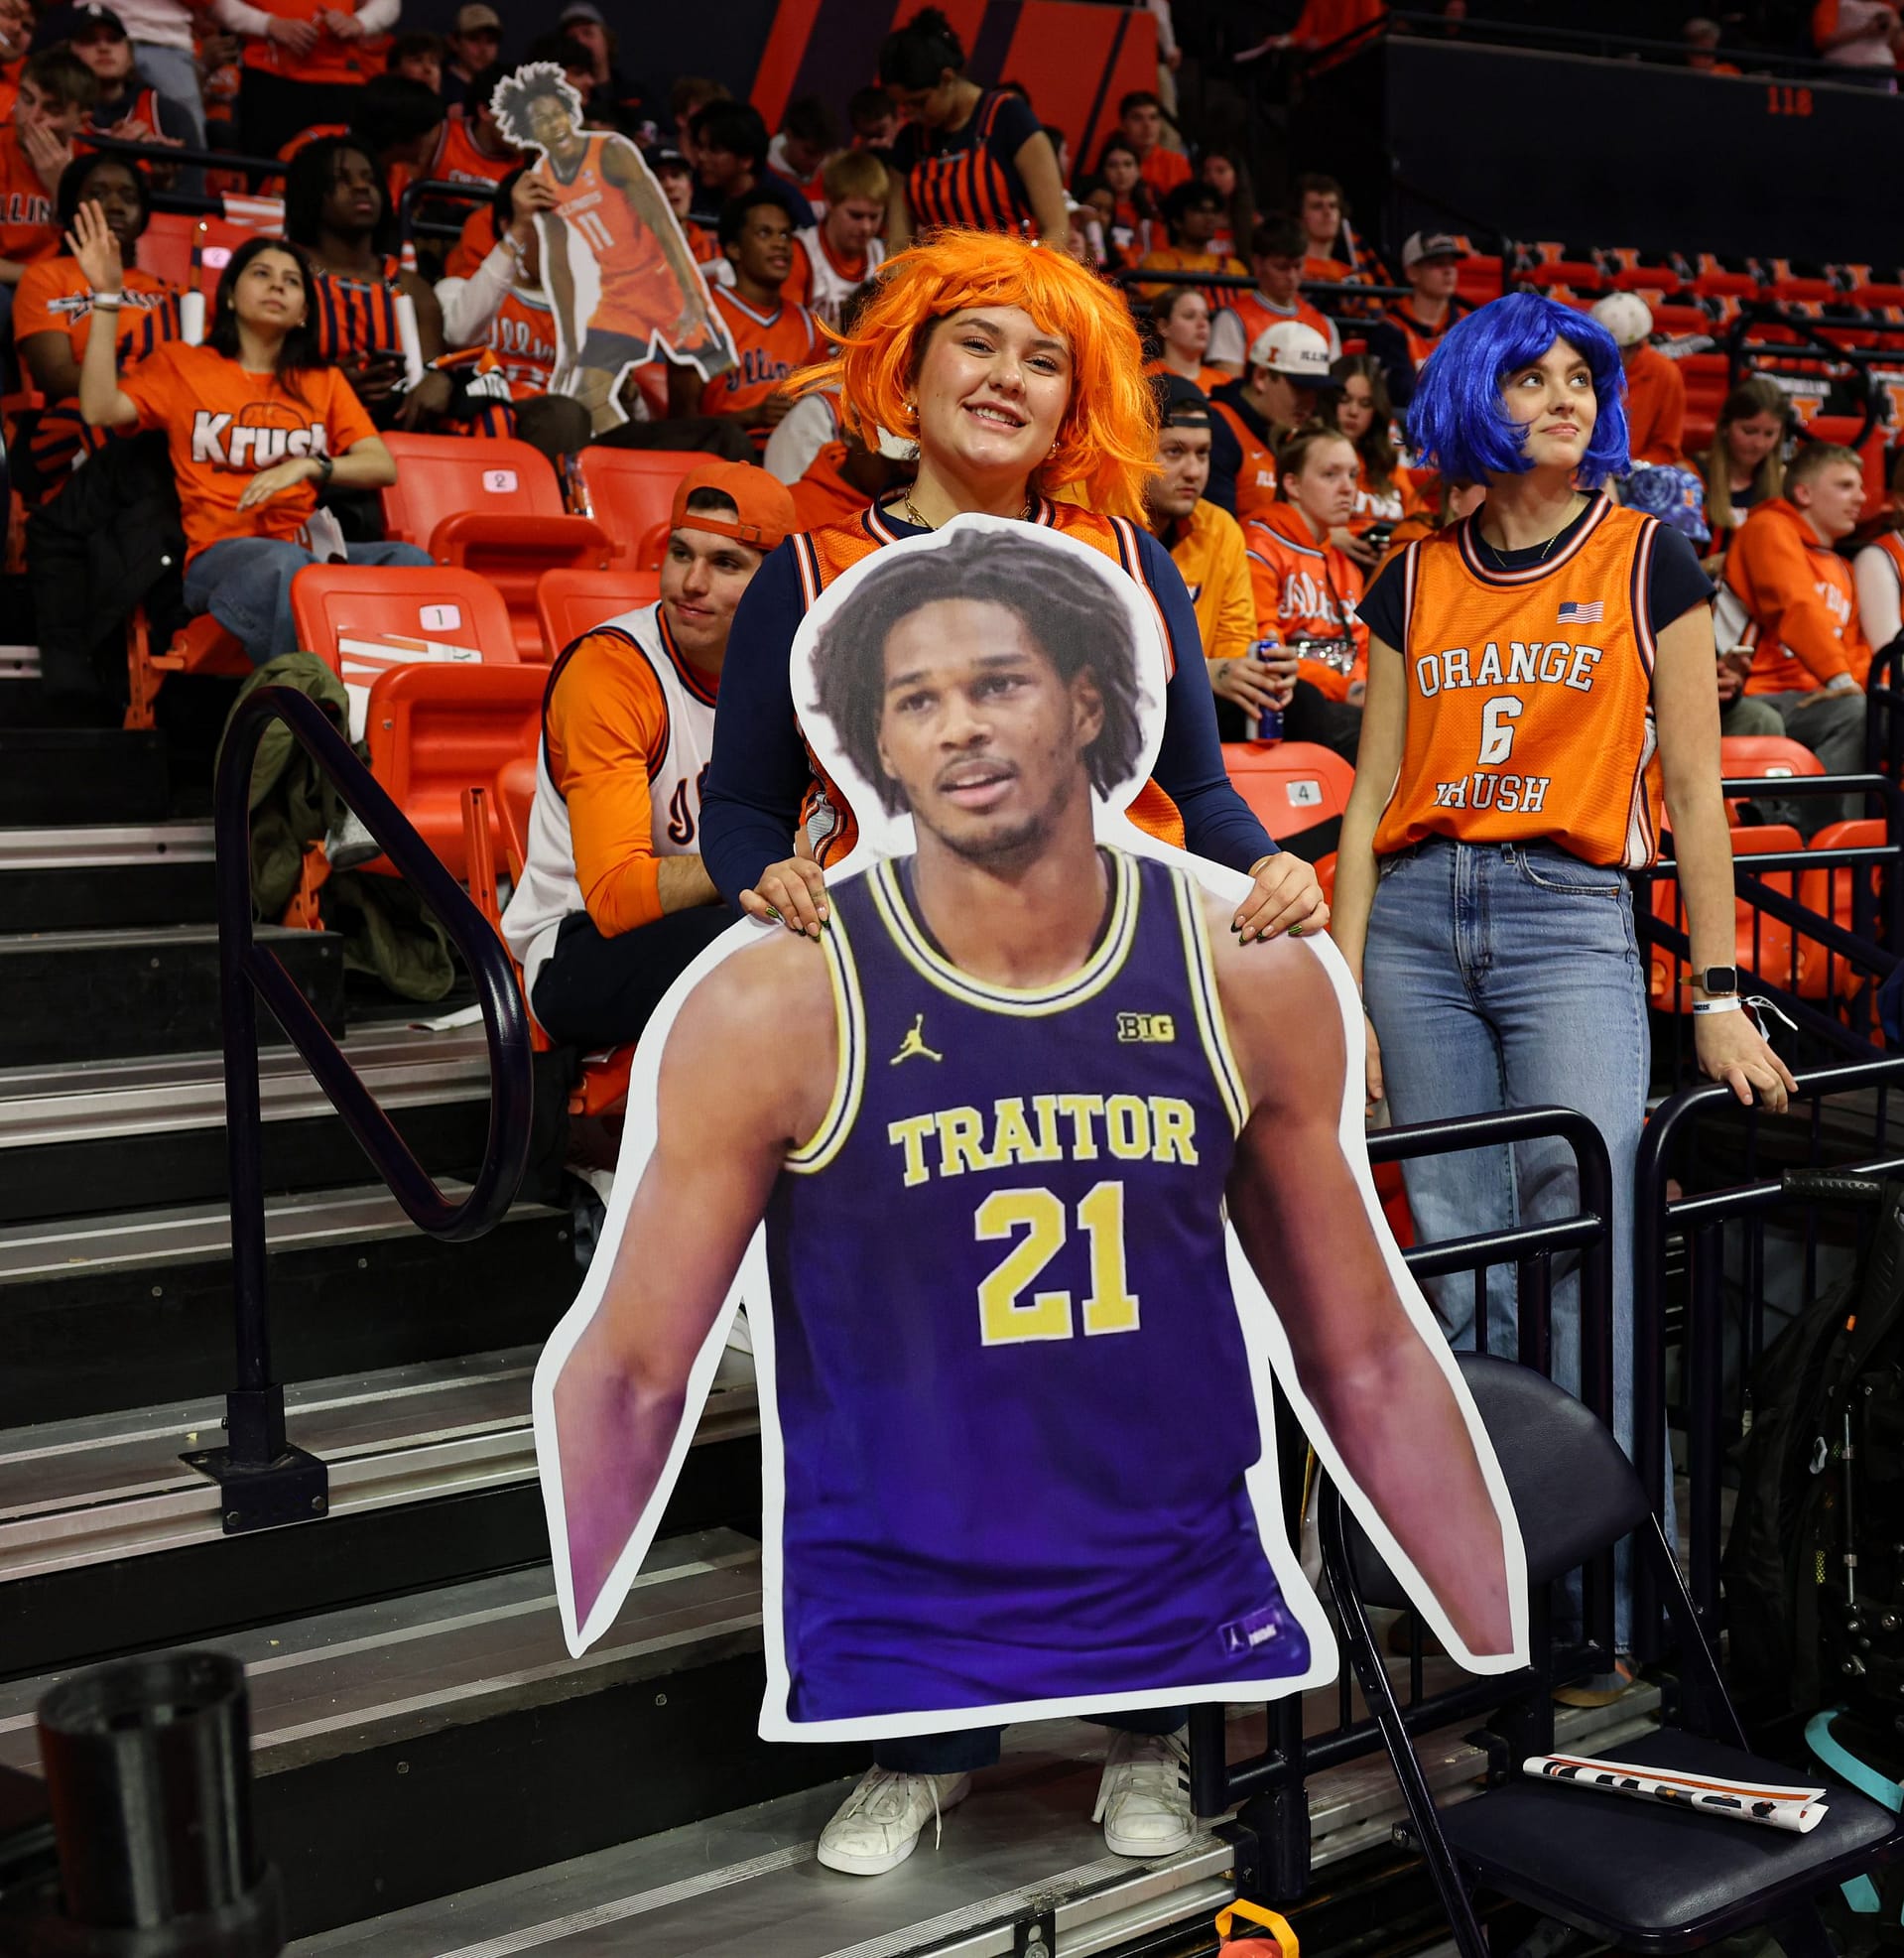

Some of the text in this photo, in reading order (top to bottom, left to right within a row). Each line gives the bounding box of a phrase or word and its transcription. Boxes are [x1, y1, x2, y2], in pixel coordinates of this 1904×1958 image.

[1768, 85, 1814, 117] 118
[576, 209, 615, 251] 11
[494, 472, 507, 487] 2
[1416, 641, 1603, 698] ORANGE
[1477, 696, 1524, 766] 6
[1299, 785, 1310, 801] 4
[1117, 1012, 1176, 1042] BIG
[888, 1094, 1199, 1188] TRAITOR
[974, 1180, 1141, 1347] 21
